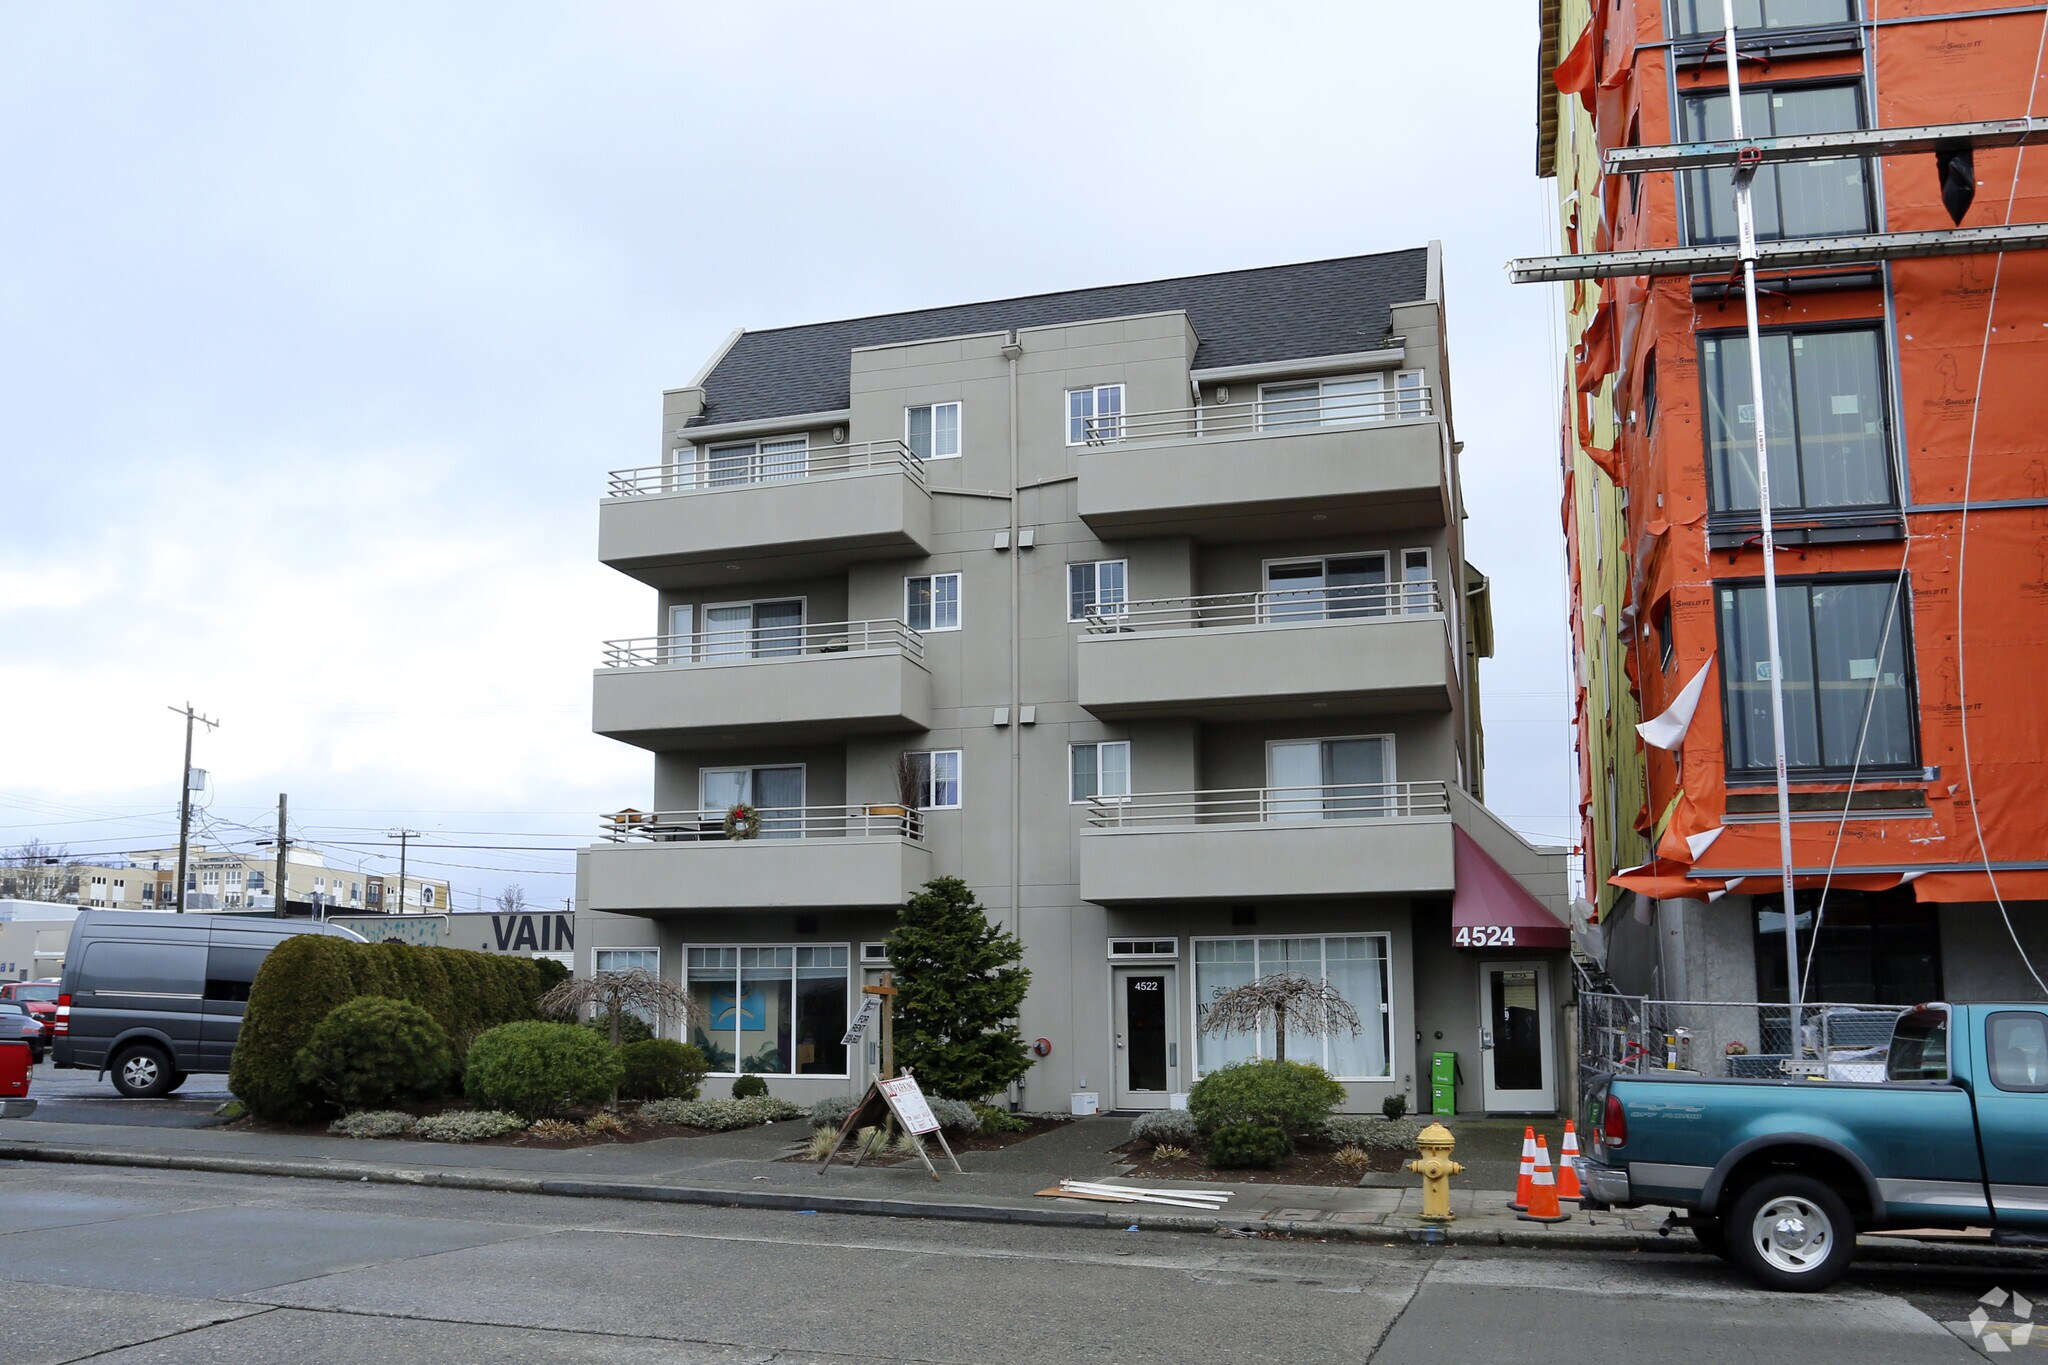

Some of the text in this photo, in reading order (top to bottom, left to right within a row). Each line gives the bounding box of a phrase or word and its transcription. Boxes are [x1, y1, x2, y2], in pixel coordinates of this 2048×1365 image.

[492, 915, 575, 951] VAIN
[1455, 926, 1516, 947] 4524
[1135, 981, 1158, 991] 4522
[858, 1015, 870, 1024] FOR
[851, 1023, 867, 1032] RENT
[1662, 1112, 1703, 1120] ROAD
